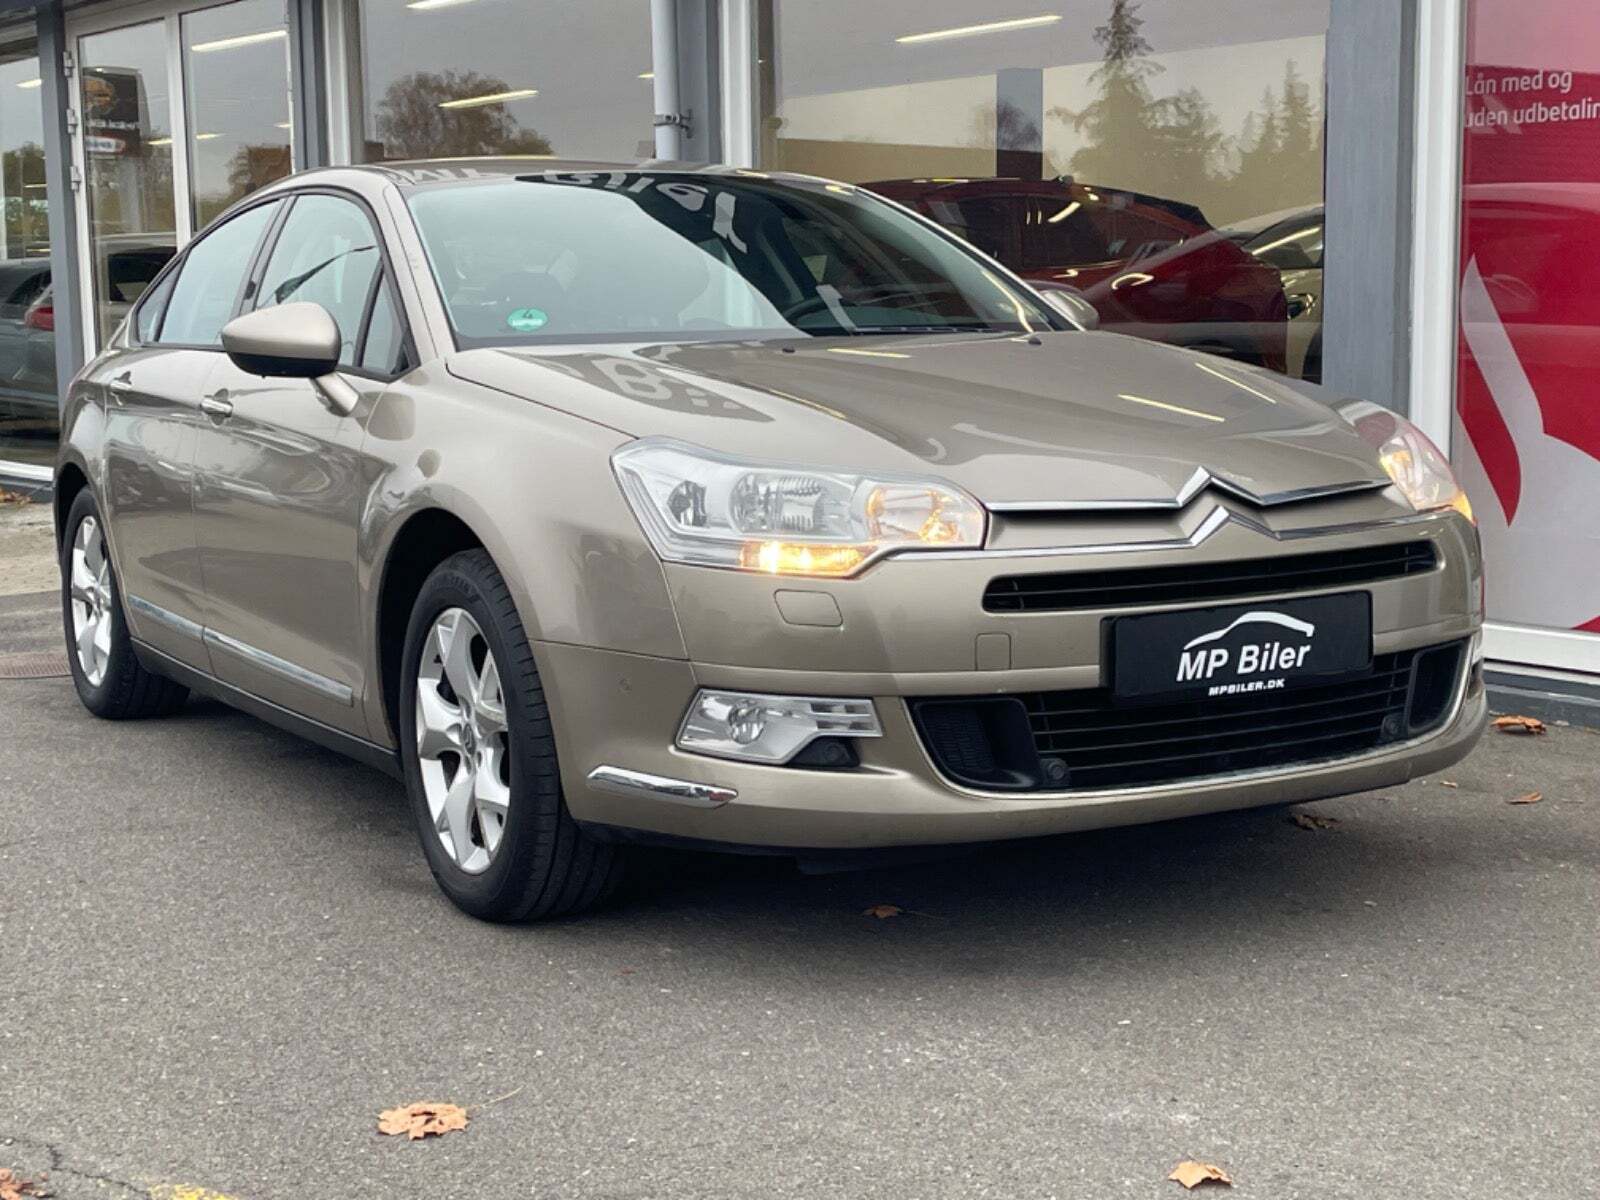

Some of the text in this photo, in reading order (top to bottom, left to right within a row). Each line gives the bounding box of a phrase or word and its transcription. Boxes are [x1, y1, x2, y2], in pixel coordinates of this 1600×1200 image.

[1465, 69, 1573, 95] Lån med og
[1175, 641, 1312, 682] MP Biler
[1208, 678, 1285, 697] MPBILER.DK
